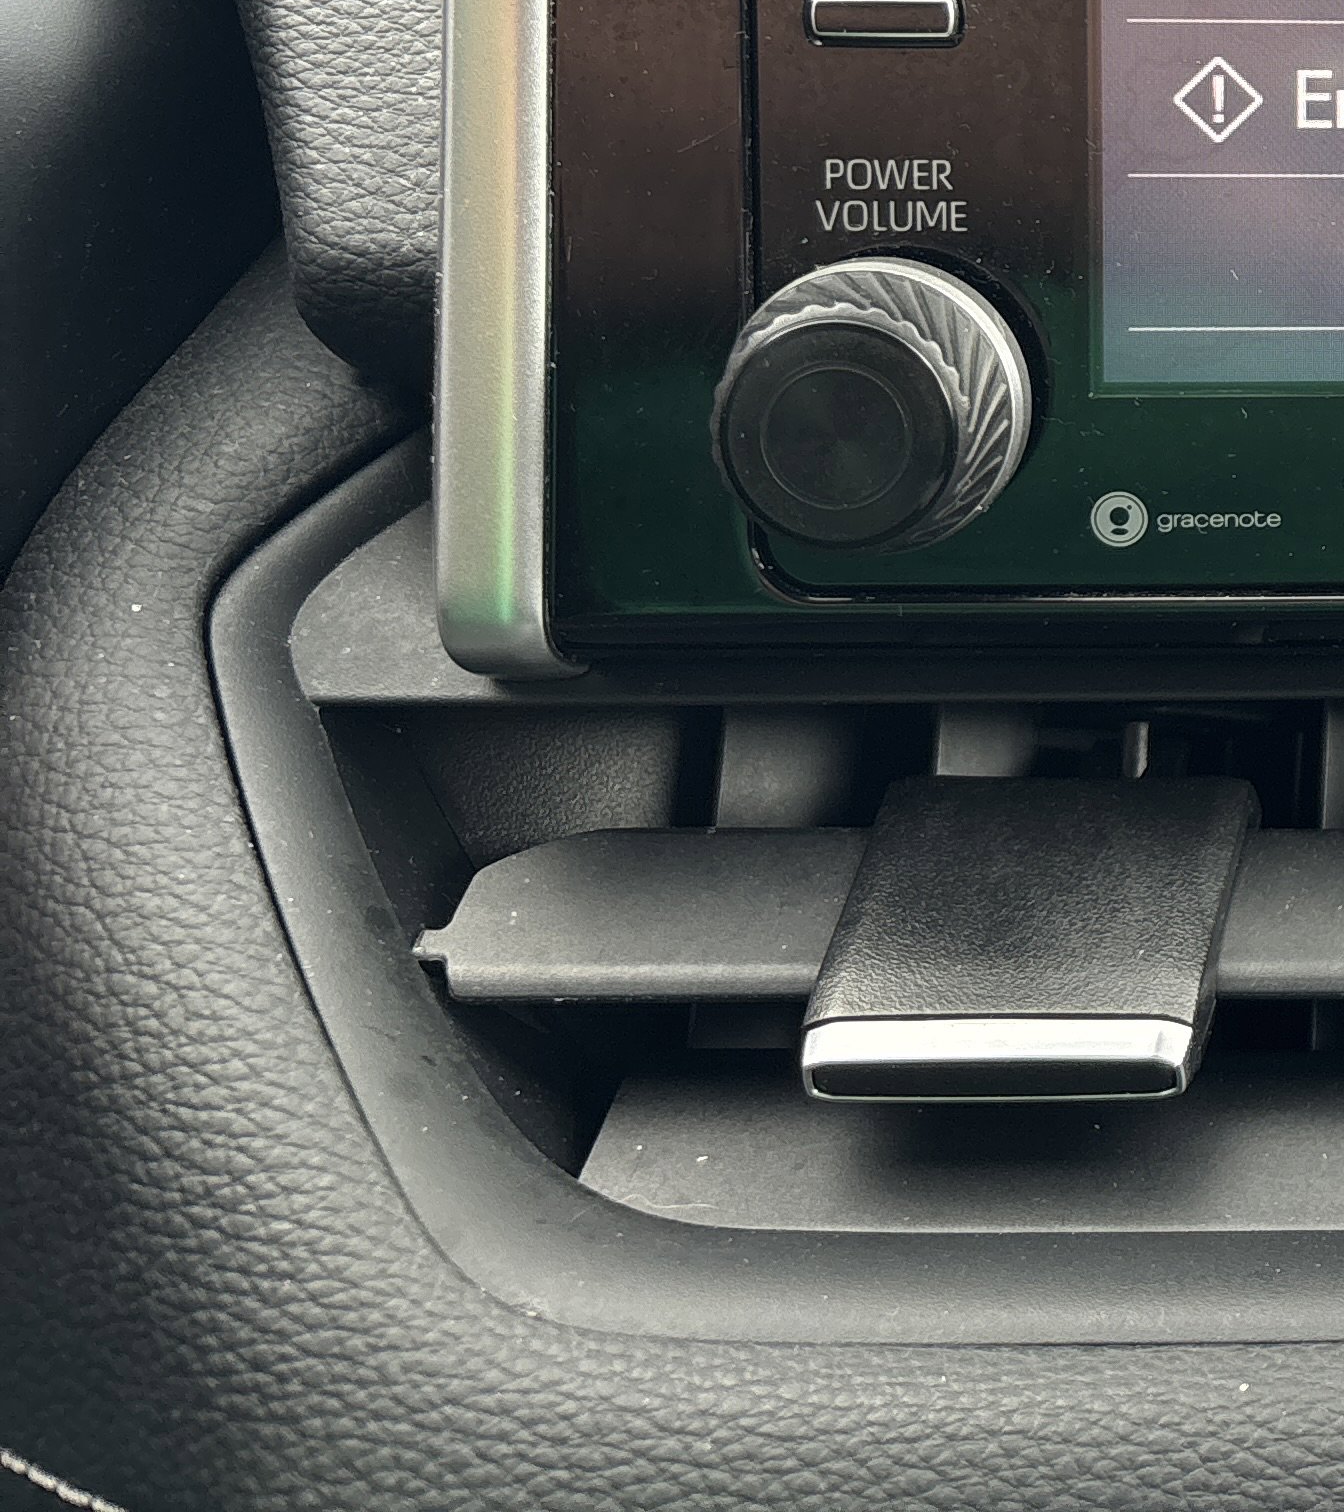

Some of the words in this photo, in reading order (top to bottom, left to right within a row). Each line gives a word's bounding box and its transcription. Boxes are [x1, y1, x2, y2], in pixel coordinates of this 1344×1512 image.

[826, 159, 952, 189] POWER
[816, 201, 967, 231] VOLUME
[1157, 511, 1281, 532] gracenote
